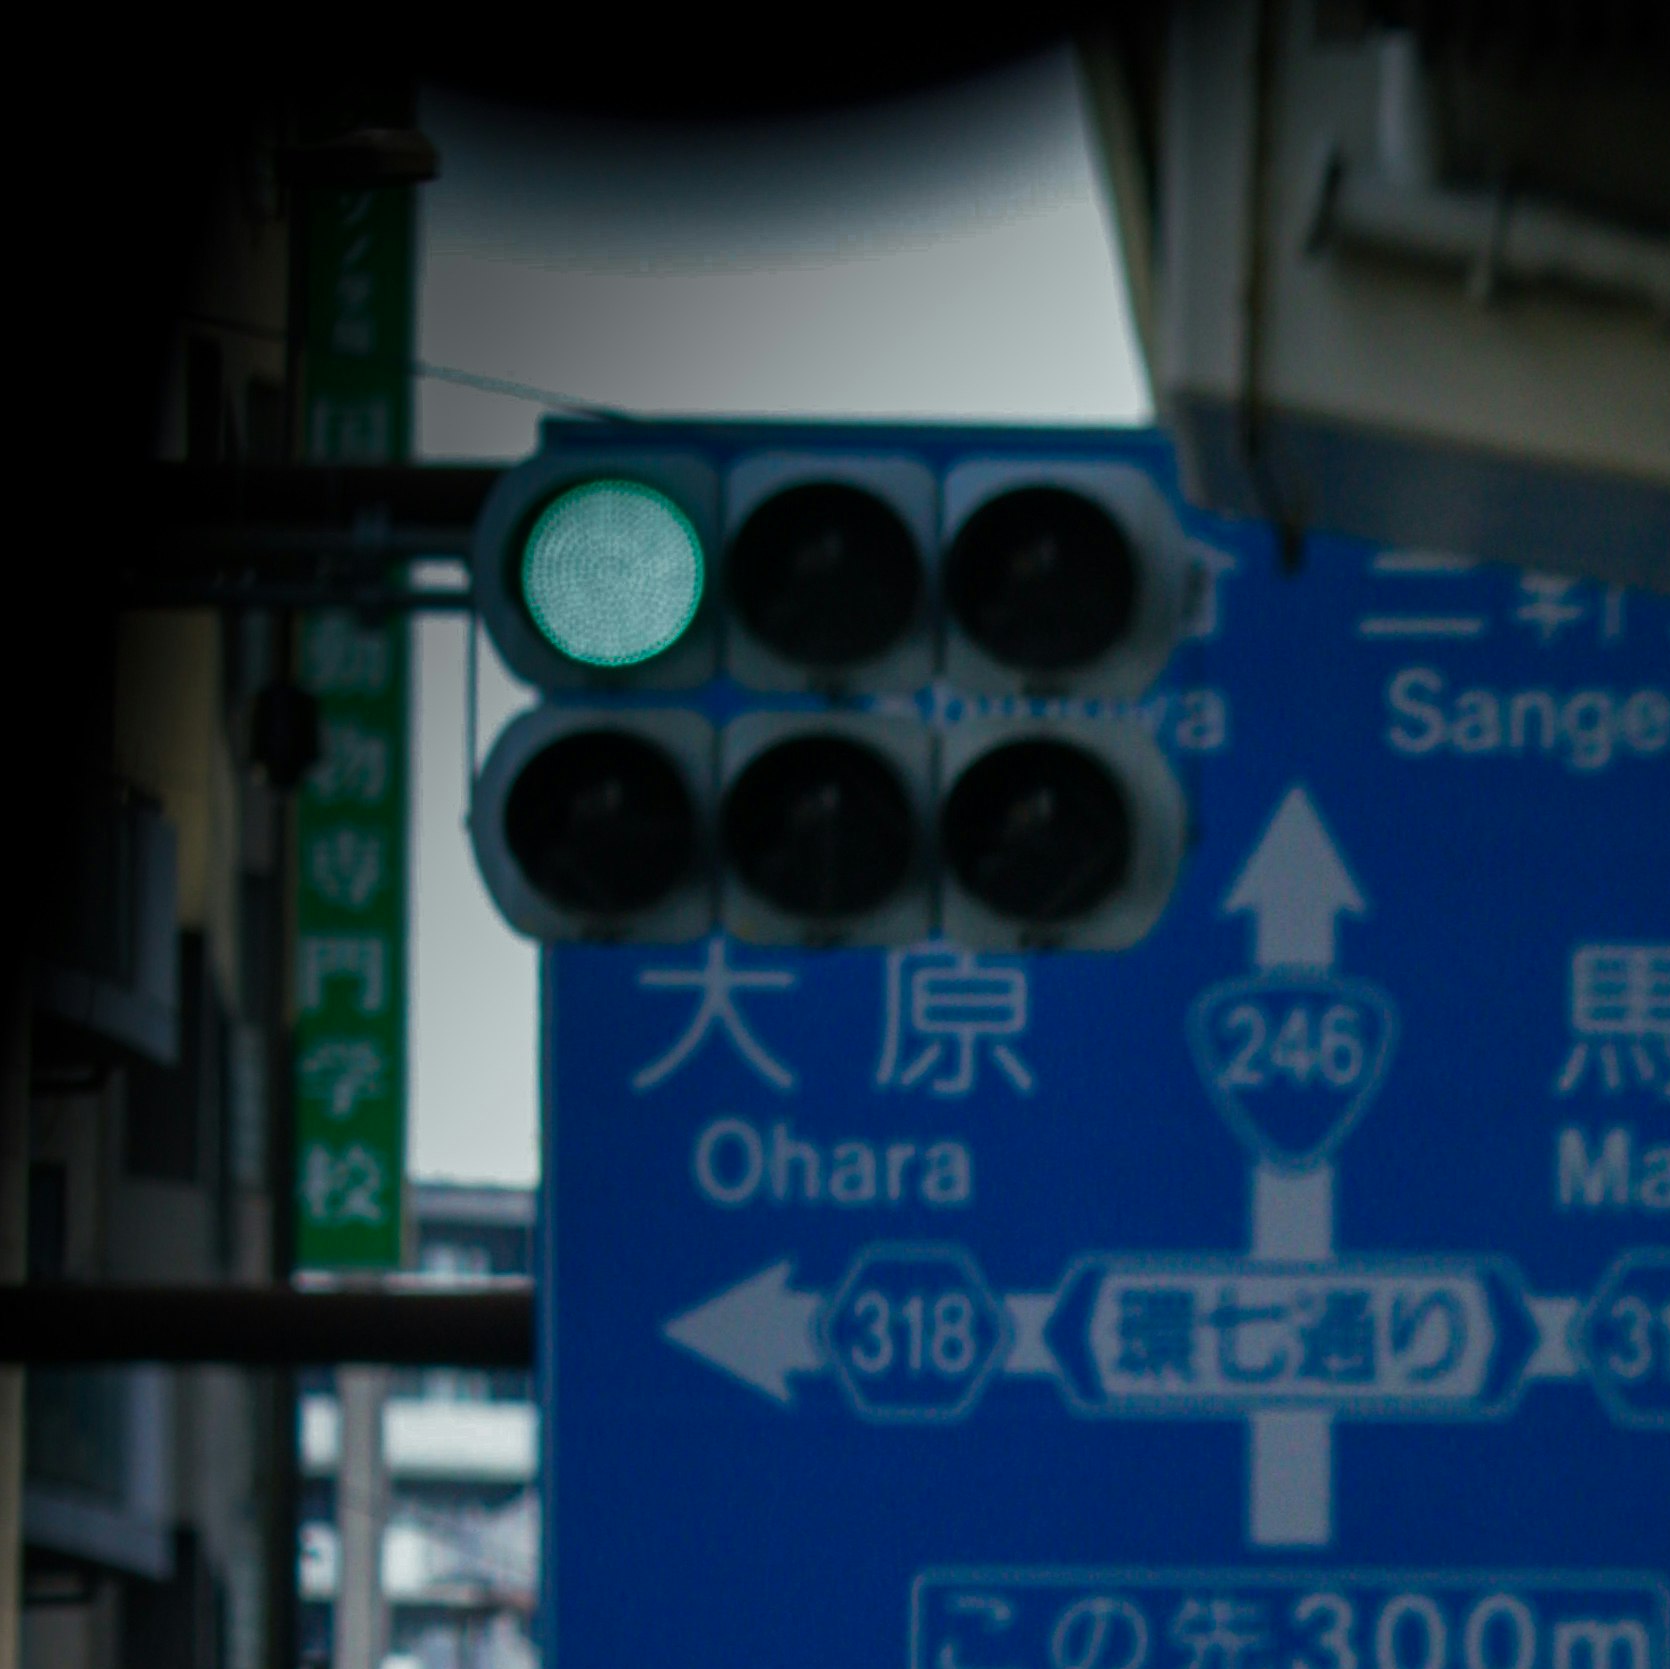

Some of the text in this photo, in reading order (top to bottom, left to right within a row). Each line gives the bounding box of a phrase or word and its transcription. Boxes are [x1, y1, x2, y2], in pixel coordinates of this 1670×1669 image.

[632, 937, 1034, 1093] 大原
[1222, 1002, 1365, 1088] 246
[695, 1117, 972, 1205] Ohara
[849, 1290, 976, 1374] 318
